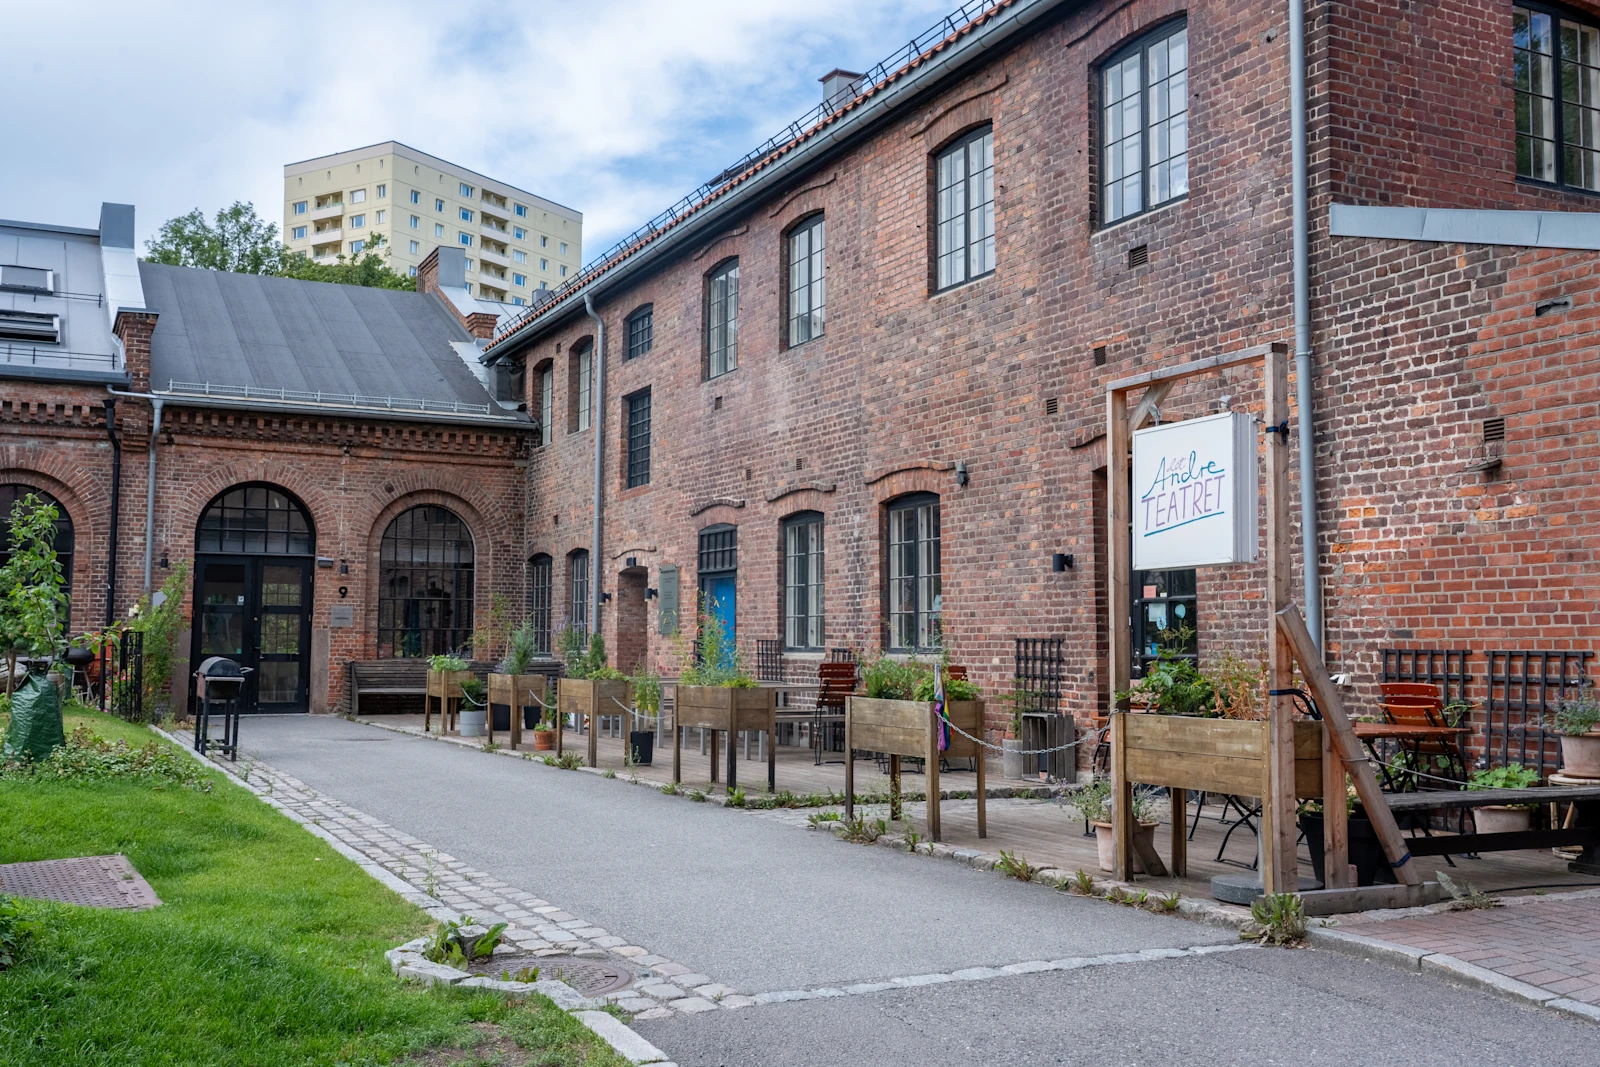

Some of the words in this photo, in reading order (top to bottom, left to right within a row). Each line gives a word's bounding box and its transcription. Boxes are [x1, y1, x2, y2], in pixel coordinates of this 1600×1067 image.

[1142, 450, 1225, 499] Andre
[1141, 474, 1225, 530] TEATRET
[338, 586, 348, 599] 9
